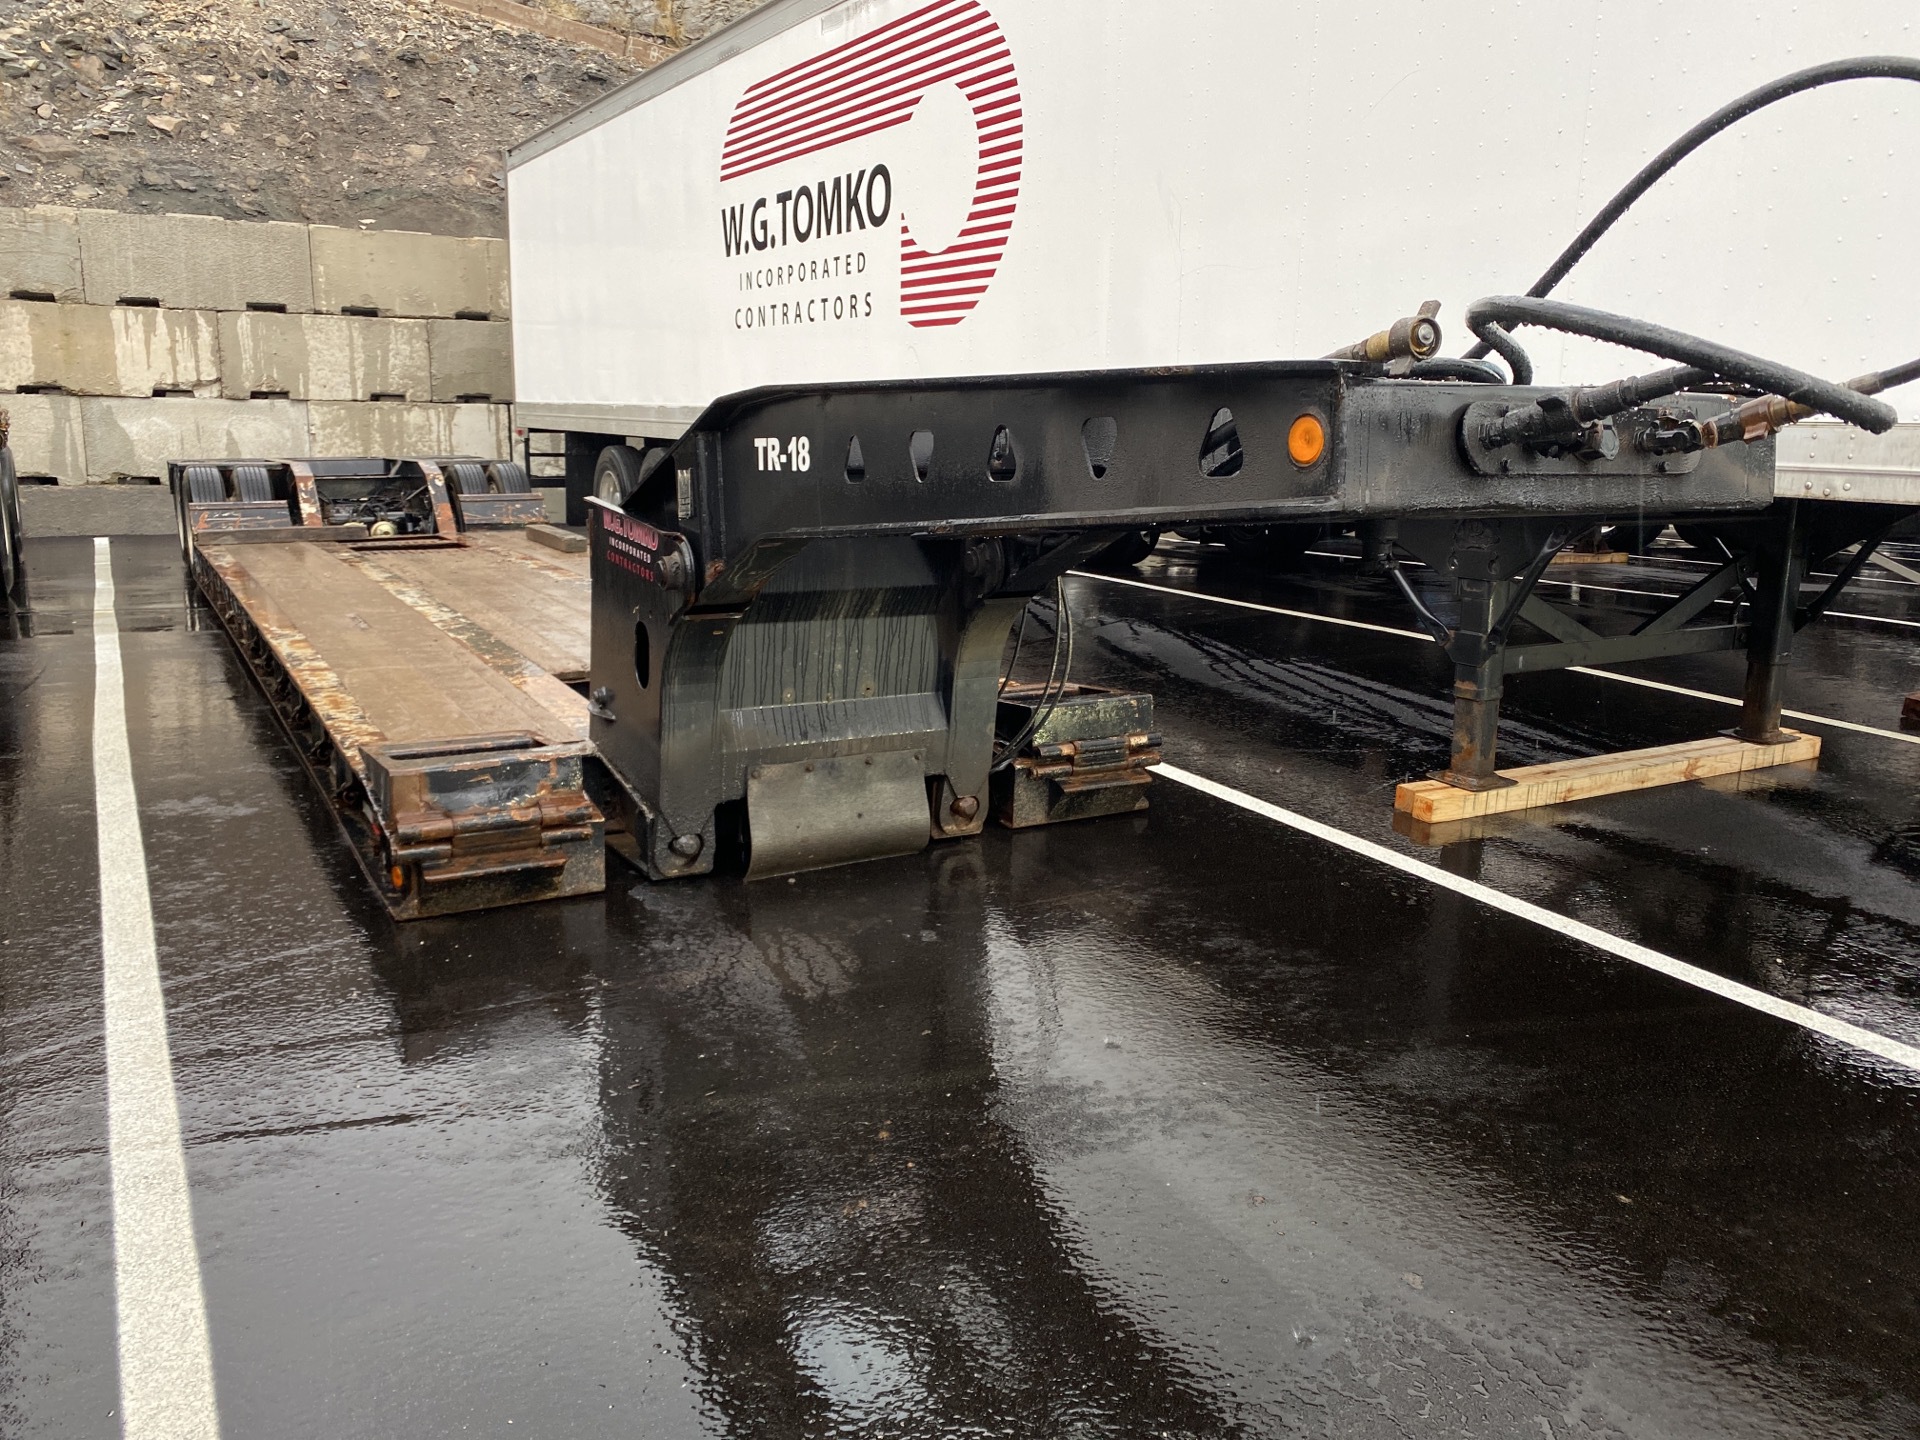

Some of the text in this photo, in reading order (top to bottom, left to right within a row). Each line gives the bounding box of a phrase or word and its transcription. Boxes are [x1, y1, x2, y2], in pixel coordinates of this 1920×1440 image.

[721, 163, 892, 257] W.G.TOMKO
[739, 251, 866, 291] INCORPORATED
[734, 292, 872, 330] CONTRACTORS
[754, 435, 811, 472] TR-18
[606, 550, 654, 582] CONTRACTORS
[609, 536, 652, 564] INCORPORATED
